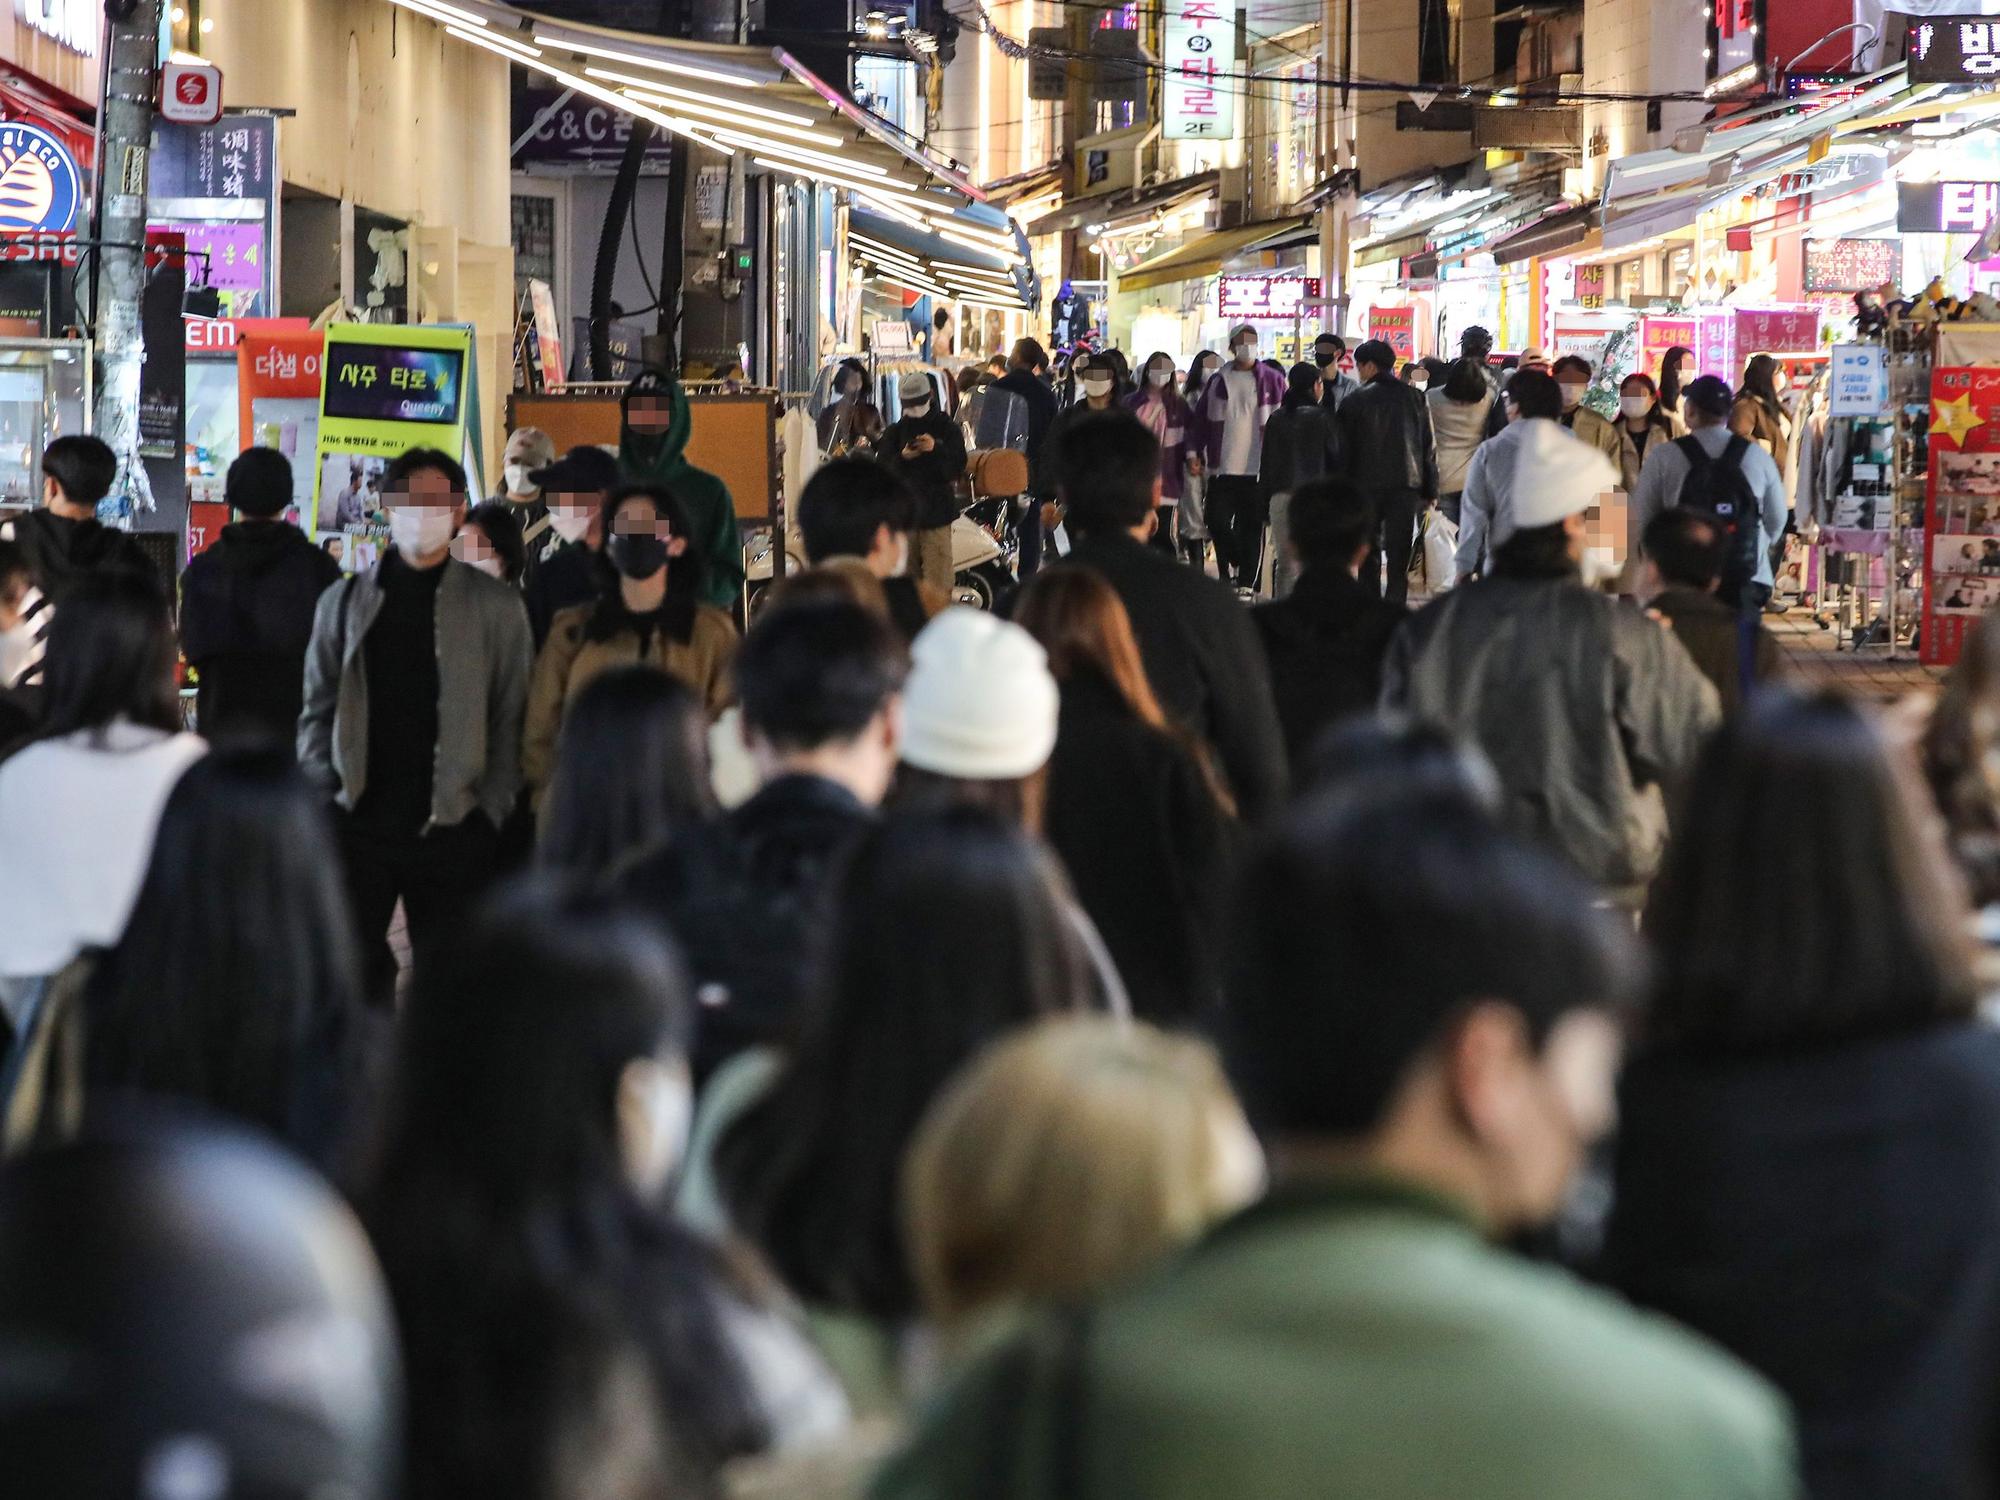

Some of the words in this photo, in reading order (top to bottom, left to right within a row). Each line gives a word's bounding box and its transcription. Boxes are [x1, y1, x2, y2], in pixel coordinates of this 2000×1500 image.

[1184, 122, 1213, 134] 2F
[1650, 327, 1704, 346] 홍대원
[255, 346, 297, 379] 더샘
[339, 363, 378, 389] 사주
[390, 367, 427, 391] 타로
[400, 399, 446, 417] Queeny
